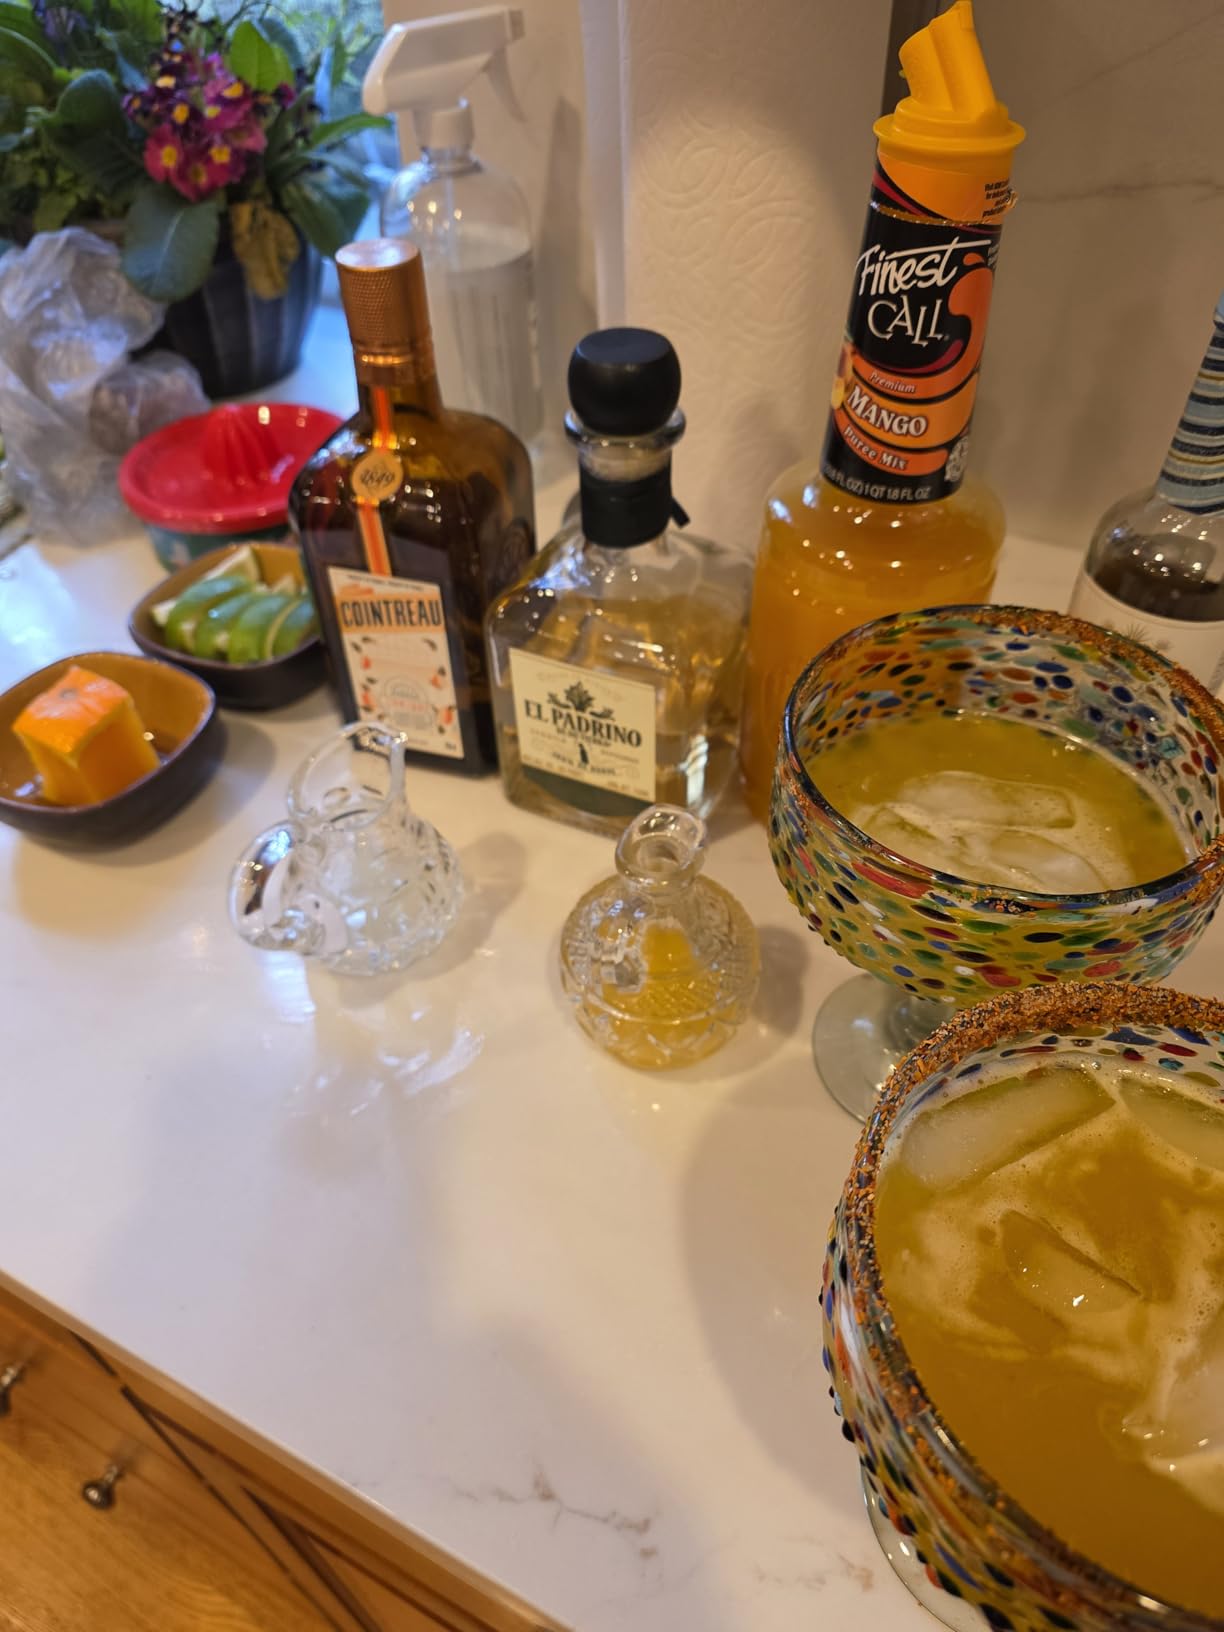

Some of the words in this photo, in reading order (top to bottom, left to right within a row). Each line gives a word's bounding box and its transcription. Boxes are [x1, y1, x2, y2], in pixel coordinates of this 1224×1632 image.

[855, 236, 992, 296] Finest
[867, 295, 943, 347] CALL
[869, 371, 916, 393] Premium
[847, 385, 928, 436] MANGO
[869, 485, 886, 500] QT
[900, 487, 914, 501] FL
[340, 600, 443, 629] COINTREAU
[523, 699, 549, 723] EL
[551, 707, 643, 749] PADRINO
